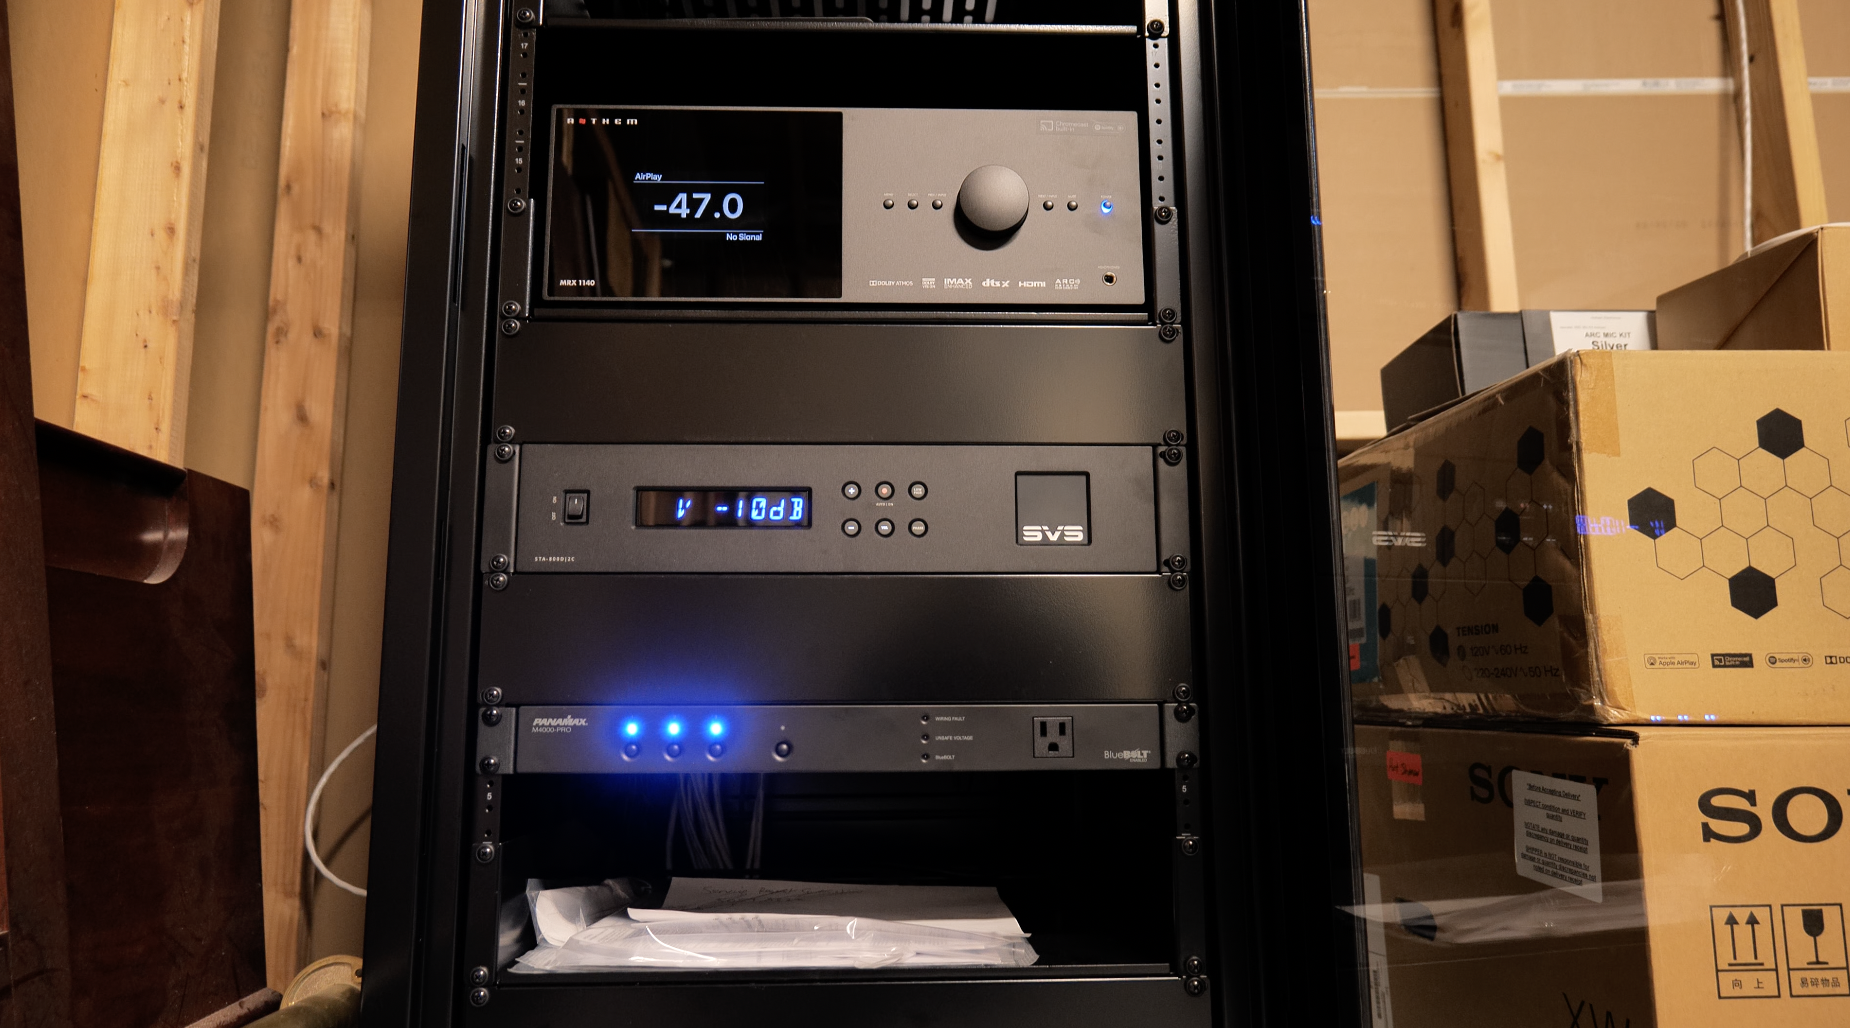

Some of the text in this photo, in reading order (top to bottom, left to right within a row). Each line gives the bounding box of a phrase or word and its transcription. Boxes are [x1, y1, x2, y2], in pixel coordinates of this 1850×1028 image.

[566, 117, 638, 125] ANTHEM
[634, 172, 663, 181] AirPlay
[653, 192, 744, 219] -47.0
[726, 233, 737, 241] No
[1591, 340, 1629, 350] Silver
[1022, 525, 1084, 542] SVS
[1456, 623, 1499, 637] TENSION
[1499, 644, 1512, 656] 60
[1514, 643, 1529, 655] Hz
[1529, 666, 1542, 678] 50
[1543, 665, 1561, 677] Hz
[532, 715, 588, 726] PANAMAX
[1103, 749, 1150, 760] BlueBOLT
[1181, 785, 1187, 793] 5
[486, 792, 492, 800] 5
[1697, 785, 1850, 843] SO
[1731, 978, 1765, 990] 向上
[1800, 977, 1841, 989] 易碎物品
